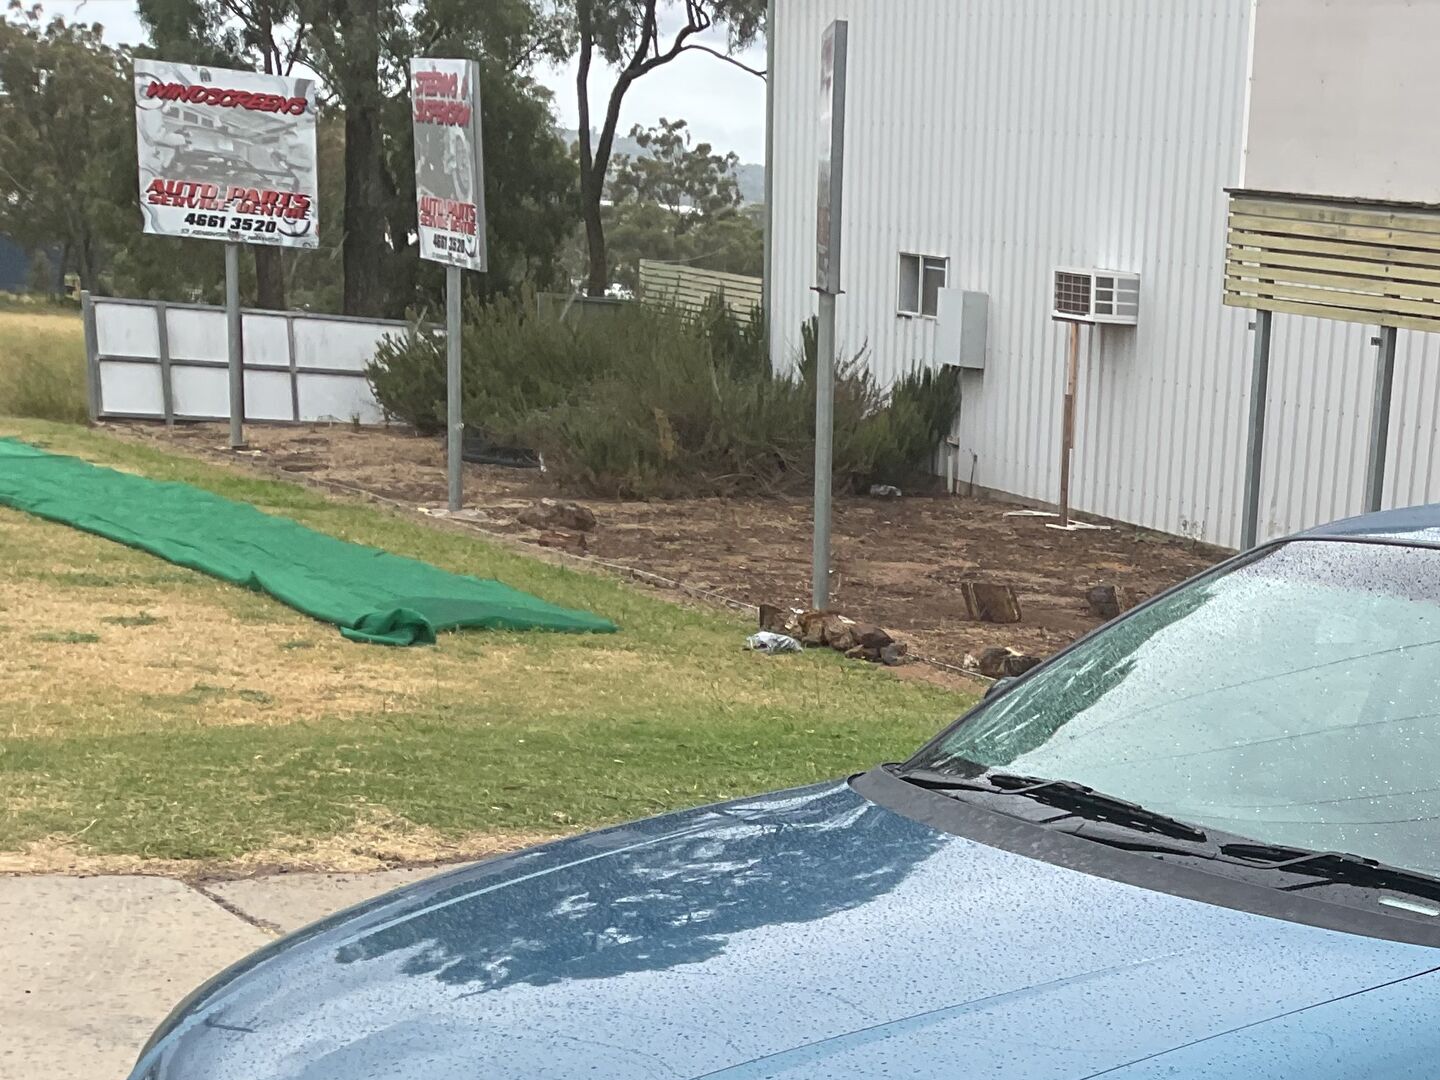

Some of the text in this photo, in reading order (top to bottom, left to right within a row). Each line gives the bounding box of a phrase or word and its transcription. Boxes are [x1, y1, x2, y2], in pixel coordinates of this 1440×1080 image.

[146, 81, 308, 116] WINDSCREENS
[146, 179, 312, 209] AUTO PARTS
[147, 193, 231, 212] SERVICE
[184, 213, 277, 233] 4661 3520
